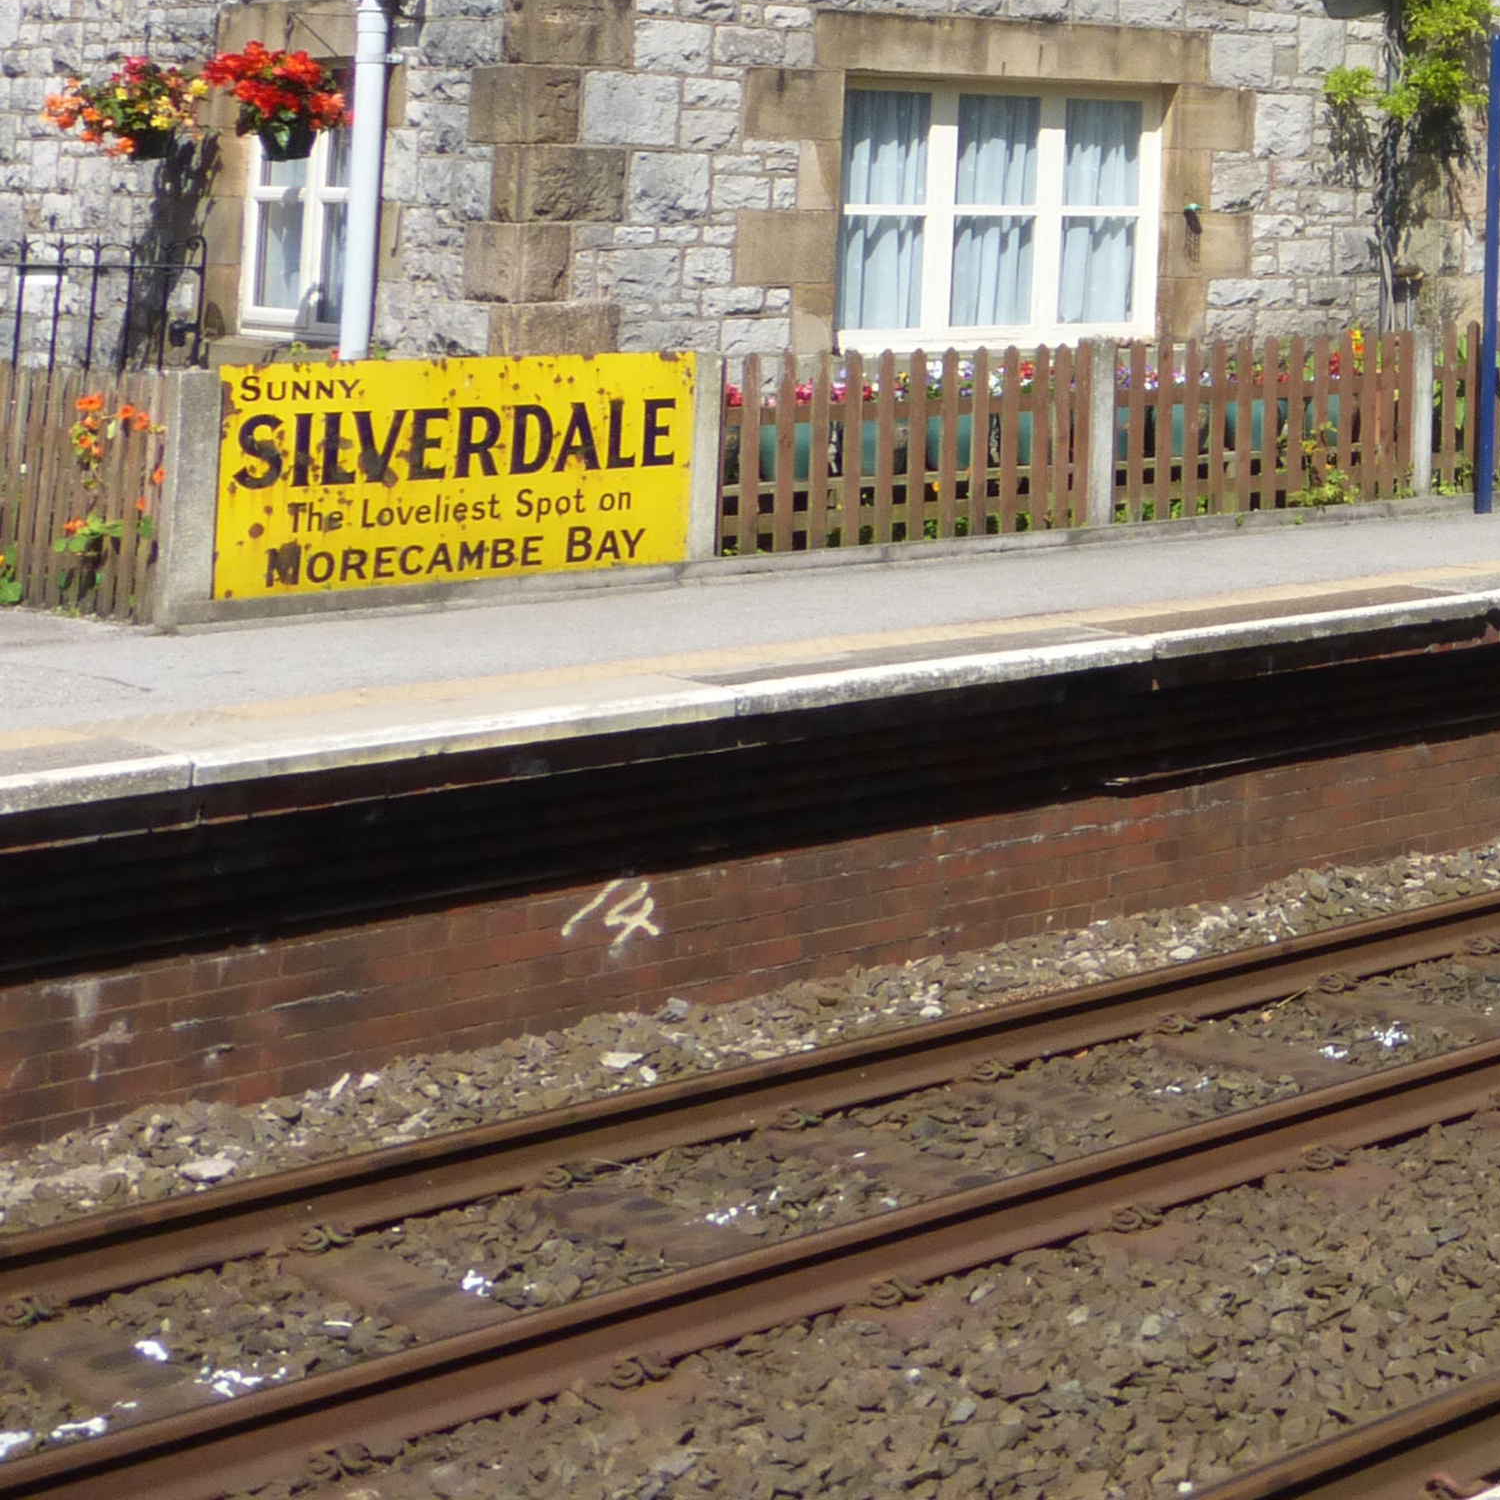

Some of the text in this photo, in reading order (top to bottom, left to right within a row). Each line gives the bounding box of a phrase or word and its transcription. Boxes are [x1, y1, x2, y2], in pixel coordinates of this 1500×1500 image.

[231, 398, 677, 490] SILVERDALE
[289, 488, 632, 533] The Loveliest Spot on
[565, 526, 646, 564] BAY
